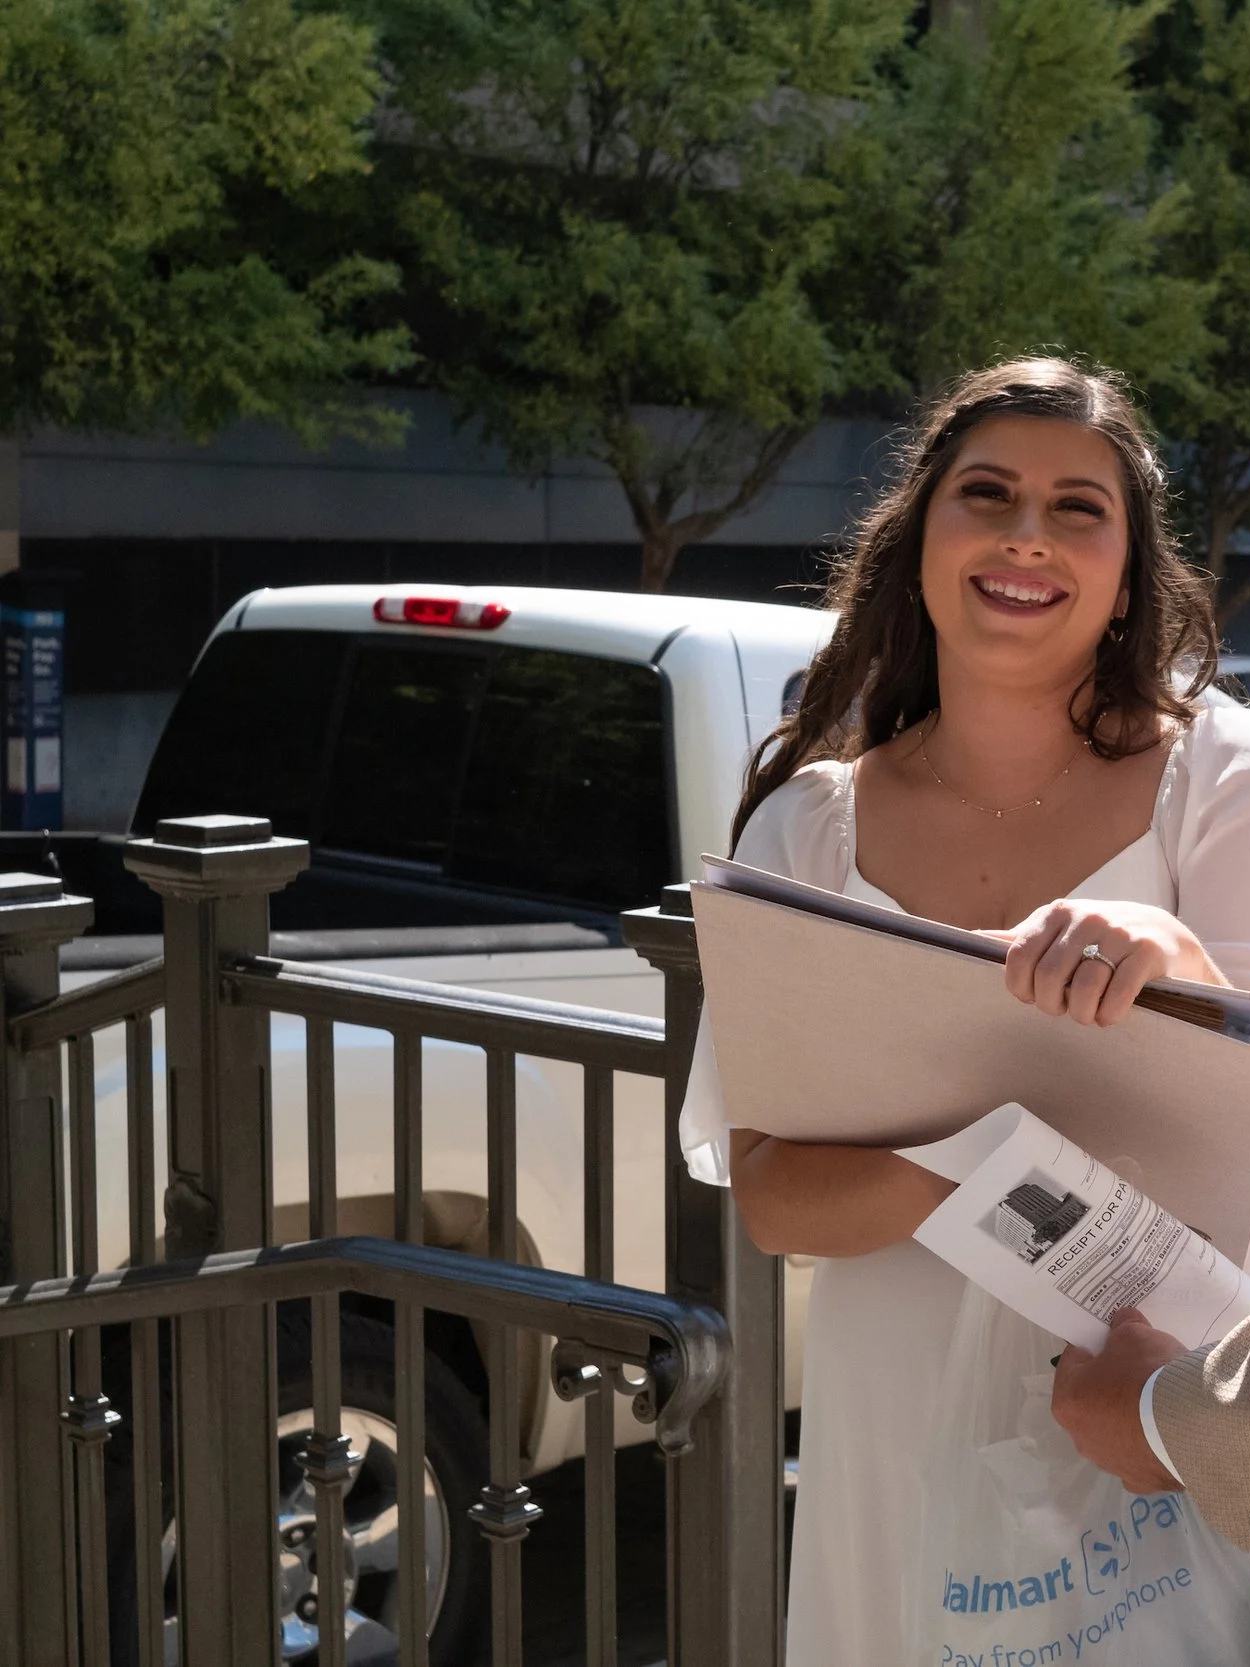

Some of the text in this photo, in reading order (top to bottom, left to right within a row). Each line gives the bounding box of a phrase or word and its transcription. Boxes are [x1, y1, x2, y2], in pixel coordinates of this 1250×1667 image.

[1048, 1178, 1127, 1275] RECEIPT FOR PA
[1143, 1212, 1164, 1242] Case Style
[1111, 1244, 1122, 1257] Paid
[1105, 1226, 1182, 1322] Total Amount Applied to Balance(s)
[1090, 1288, 1103, 1301] Case
[1127, 1280, 1155, 1307] alance Due
[991, 1641, 1061, 1667] from
[1115, 1568, 1191, 1631] phone
